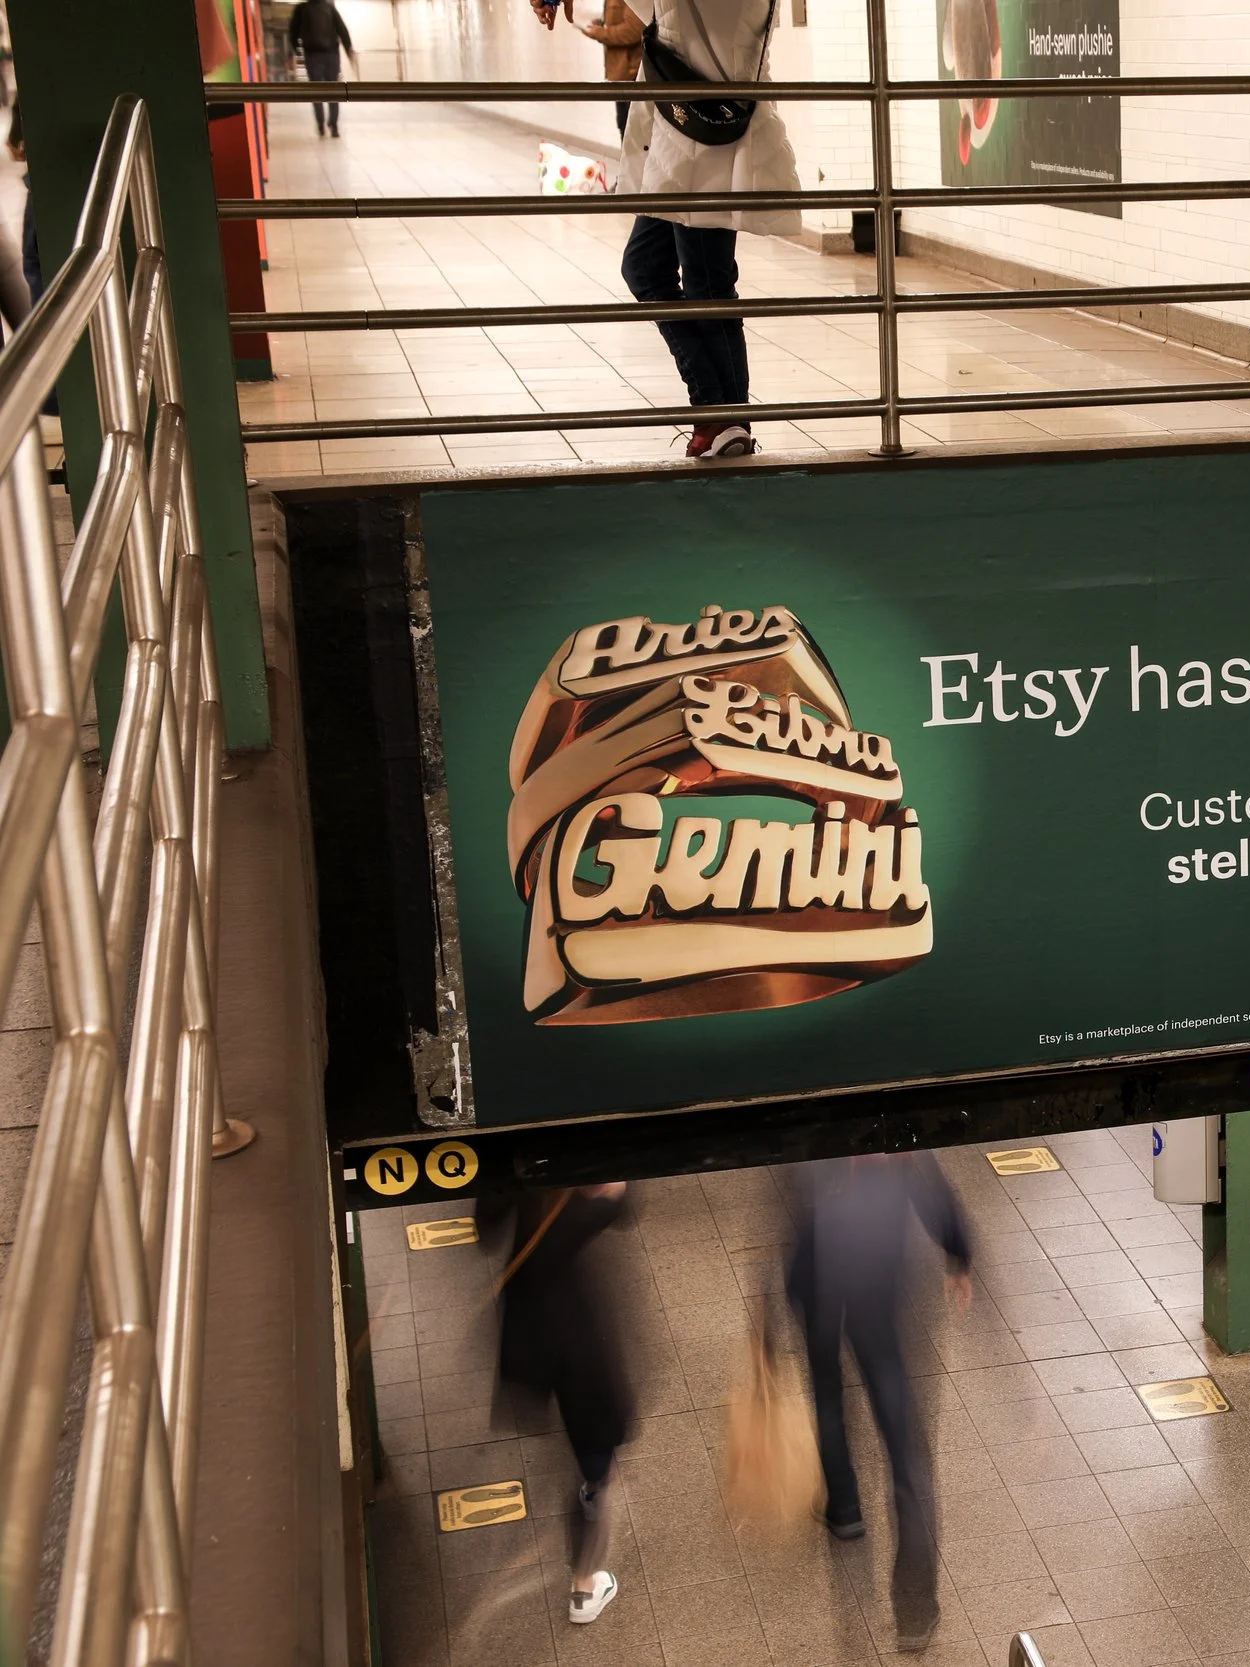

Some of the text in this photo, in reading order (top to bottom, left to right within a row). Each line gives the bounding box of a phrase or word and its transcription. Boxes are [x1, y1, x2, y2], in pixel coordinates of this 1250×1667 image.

[1028, 23, 1113, 62] Hand-sewn plushie
[562, 604, 798, 684] Aries
[682, 676, 898, 776] Libra
[920, 652, 1109, 737] Etsy
[559, 792, 929, 917] Gemini
[1039, 1034, 1062, 1044] Etsy
[1065, 1031, 1073, 1042] is
[1076, 1031, 1083, 1040] a
[1086, 1024, 1154, 1039] marketplace
[1157, 1020, 1169, 1031] of
[1171, 1013, 1240, 1030] independent
[378, 1151, 466, 1184] N Q
